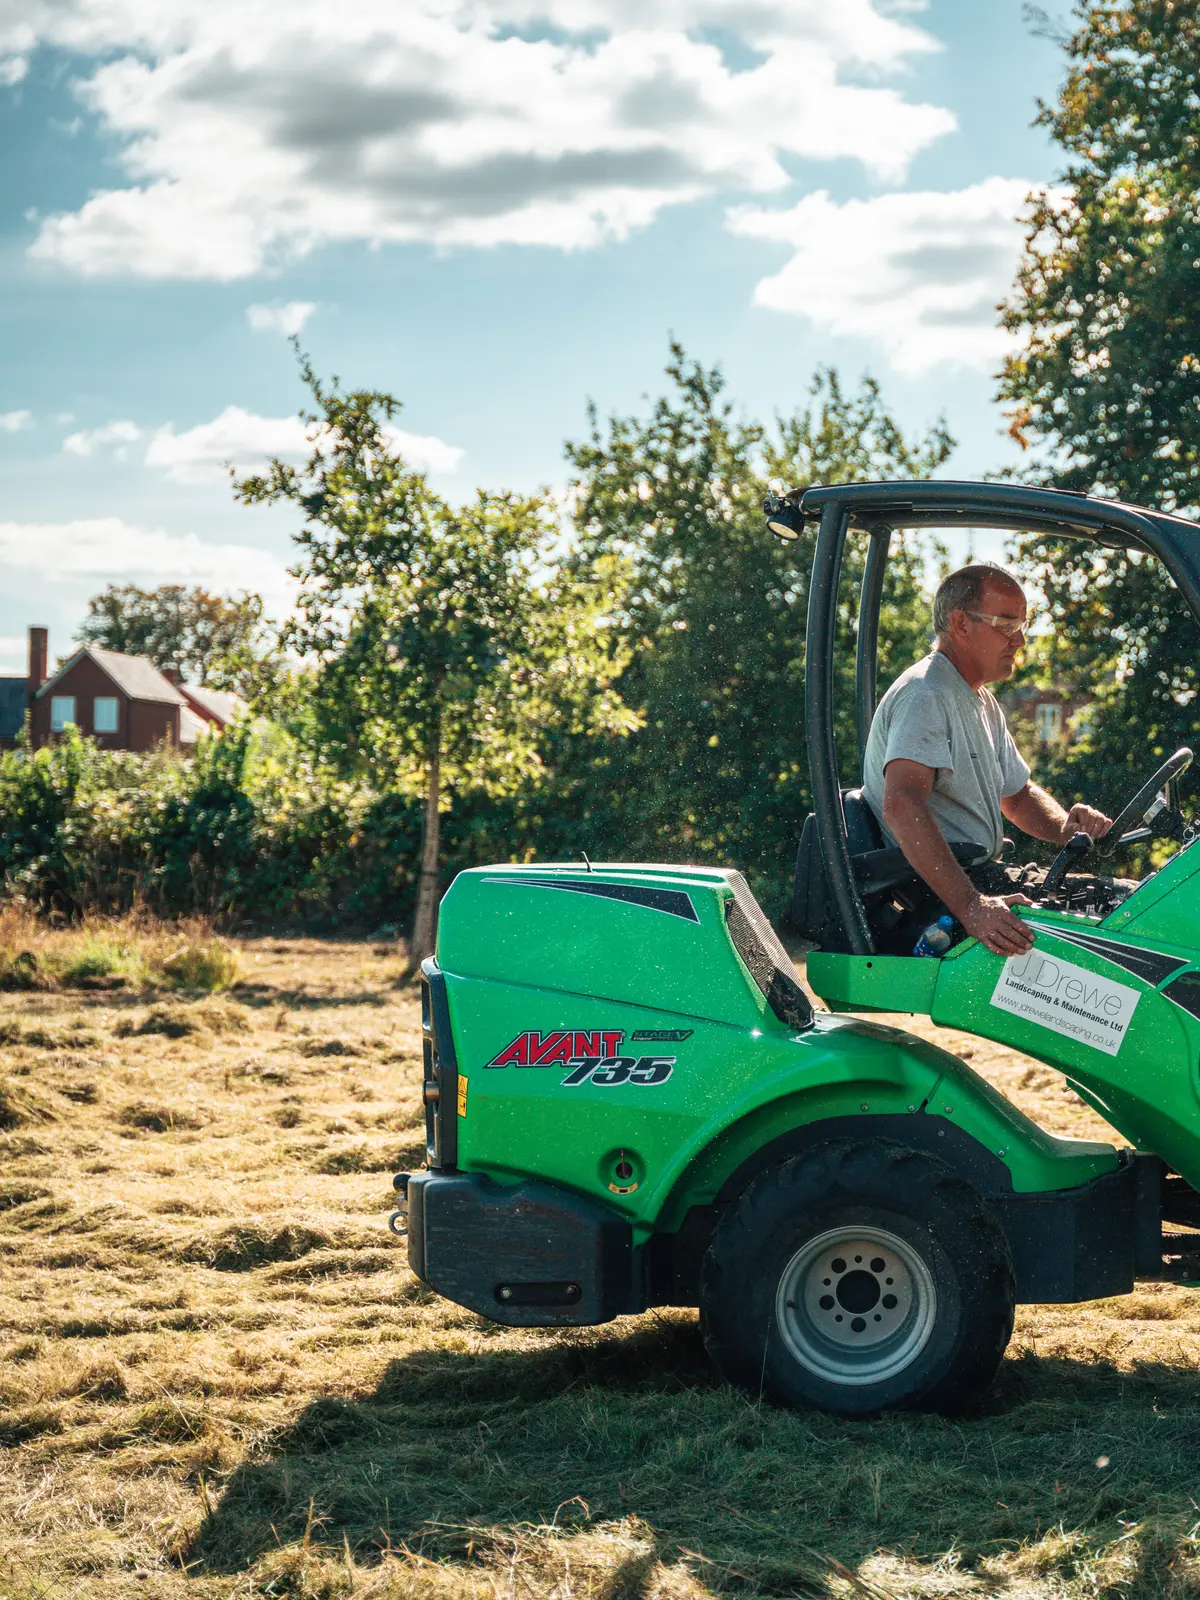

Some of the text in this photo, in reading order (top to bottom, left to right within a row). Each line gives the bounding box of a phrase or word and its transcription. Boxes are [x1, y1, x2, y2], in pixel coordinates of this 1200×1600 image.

[997, 994, 1117, 1048] www.jdrewelandscaping.co.uk
[1005, 977, 1124, 1032] Landscaping & Maintenance Ltd
[484, 1030, 624, 1068] AVANT
[560, 1056, 677, 1086] 735
